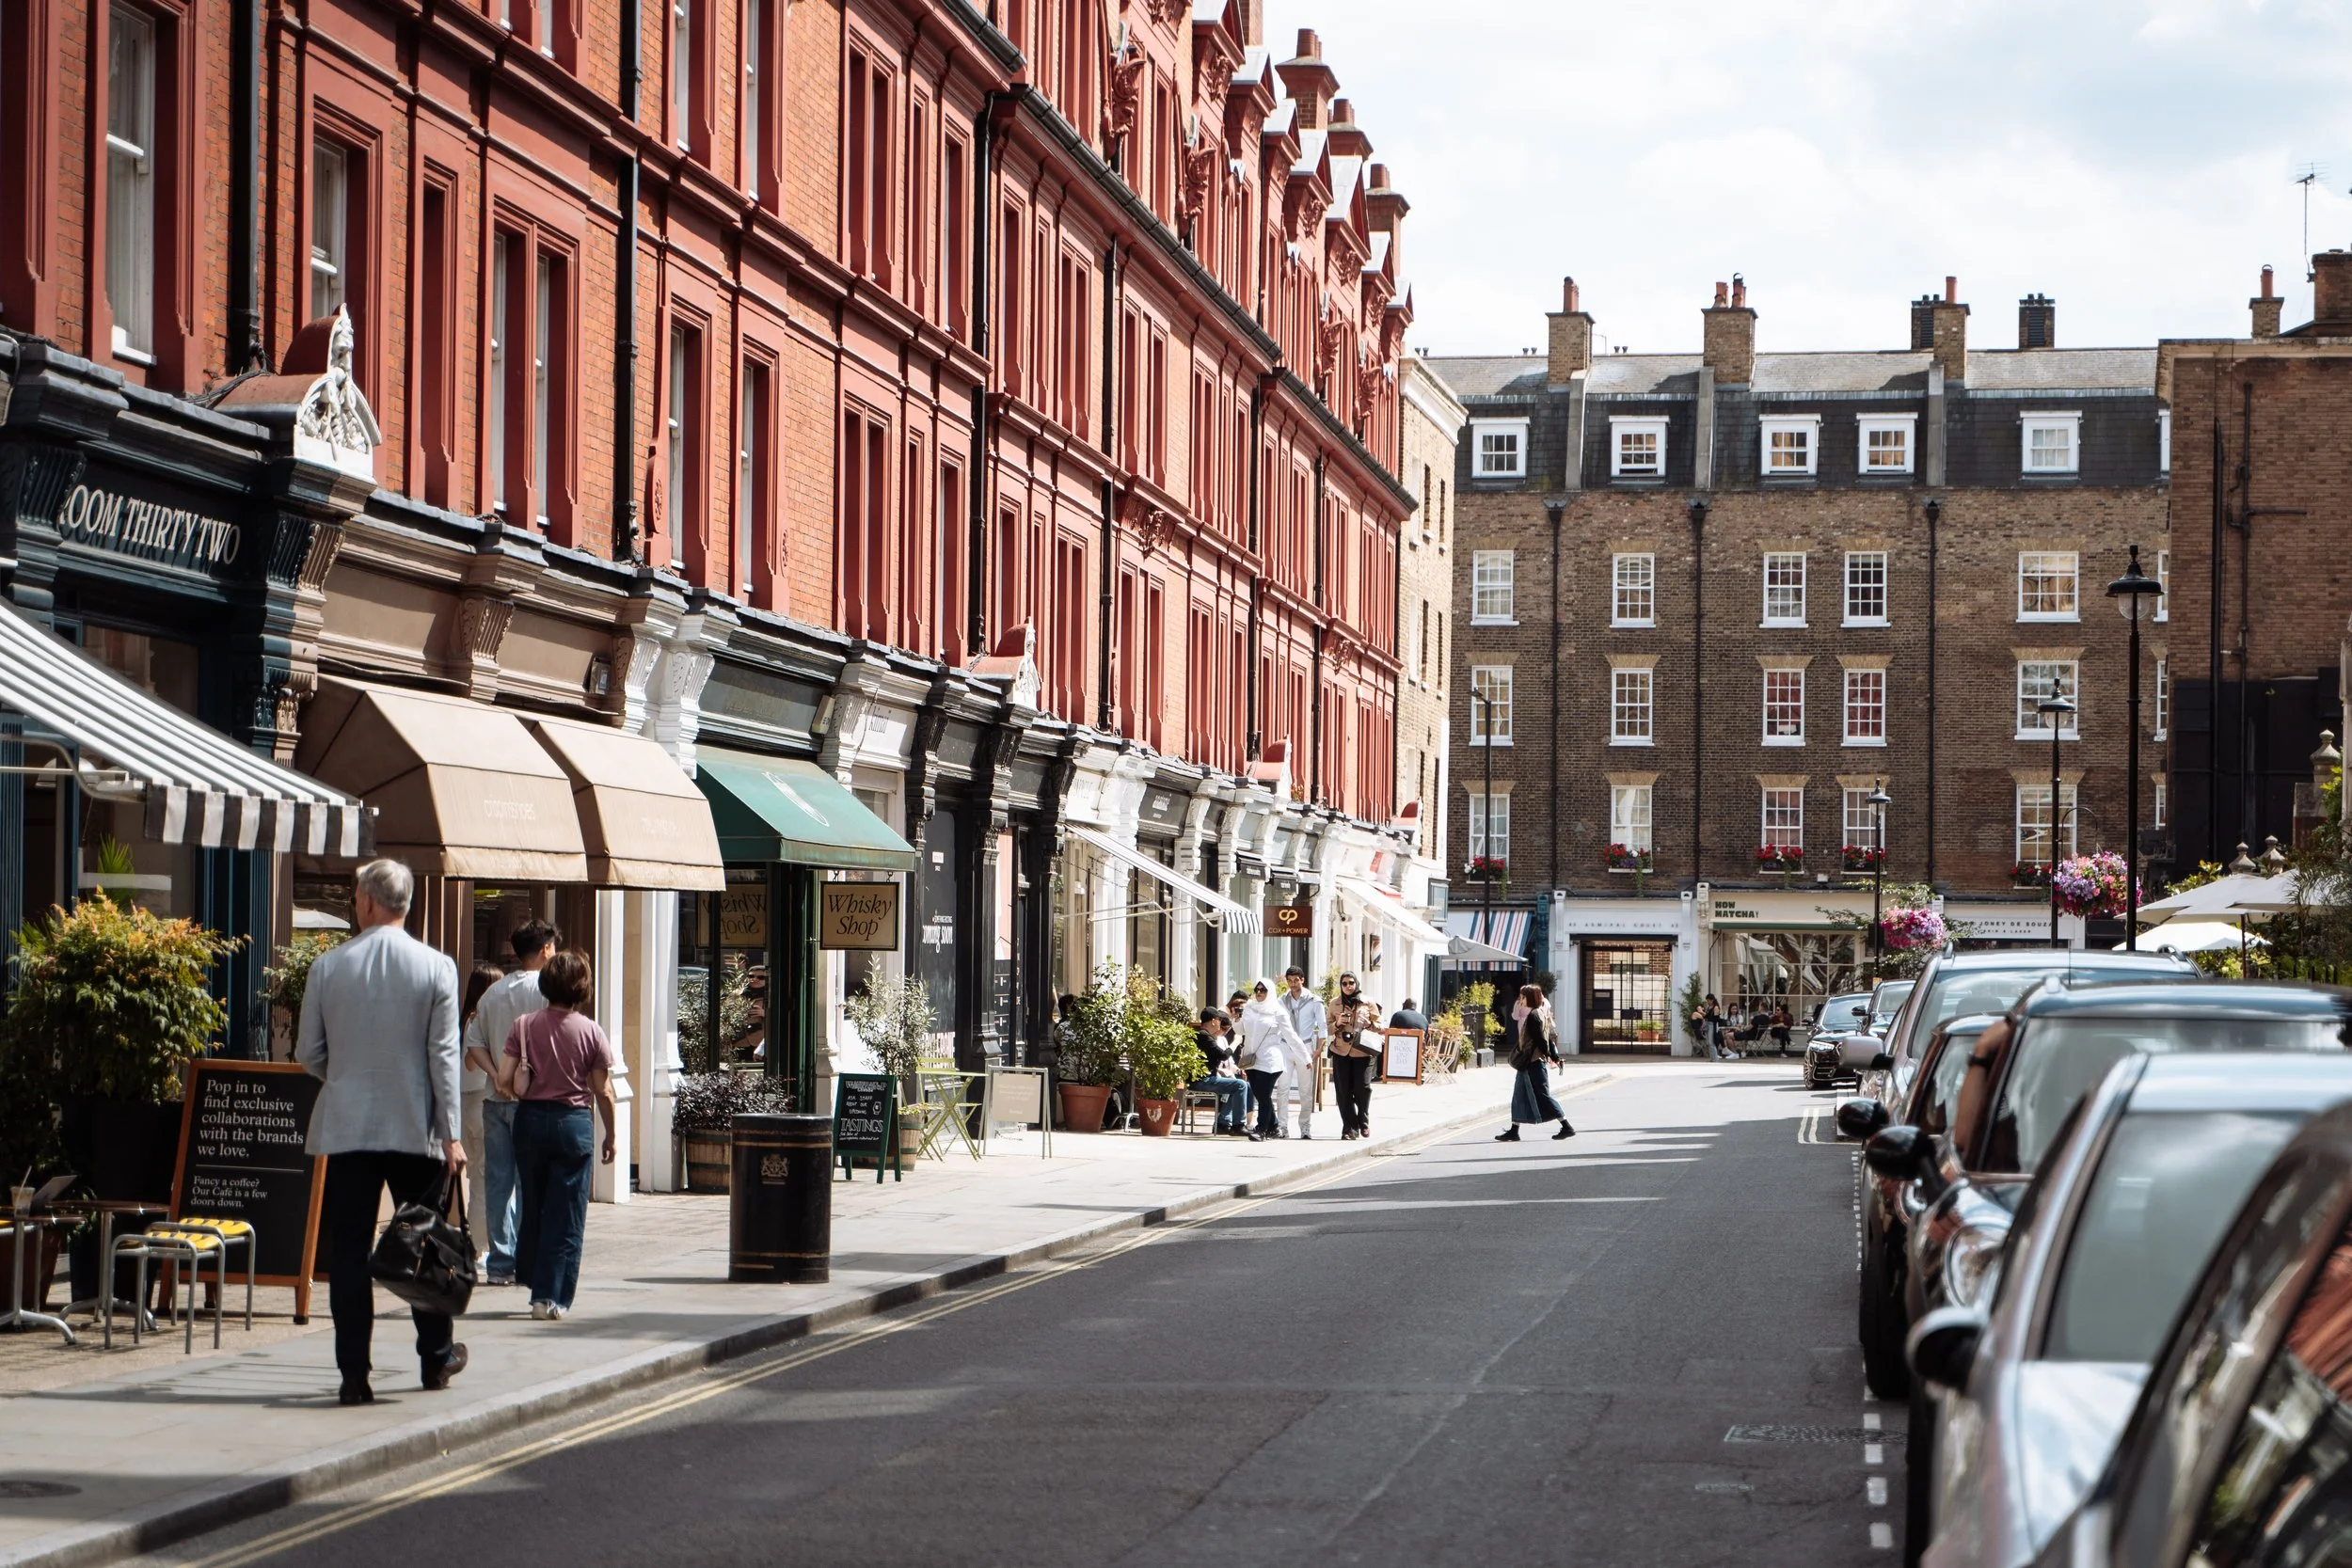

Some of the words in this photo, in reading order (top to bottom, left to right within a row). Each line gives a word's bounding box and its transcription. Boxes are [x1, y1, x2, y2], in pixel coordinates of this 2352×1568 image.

[122, 497, 199, 553] THIRTY
[196, 516, 241, 564] TWO
[828, 894, 892, 920] Whisky
[836, 916, 879, 941] Shop
[207, 1079, 231, 1095] Pop
[235, 1080, 248, 1093] in
[252, 1083, 266, 1094] to
[203, 1095, 230, 1108] find
[233, 1097, 294, 1112] exclusive
[201, 1111, 295, 1128] collaborations
[840, 1117, 883, 1132] TASTINGS
[199, 1127, 228, 1140] with
[232, 1128, 254, 1141] the
[257, 1129, 304, 1145] brands
[197, 1145, 215, 1155] we
[193, 1175, 220, 1186] Fancy
[229, 1178, 260, 1188] coffee?
[192, 1186, 210, 1196] Our
[212, 1186, 232, 1196] Café
[234, 1188, 242, 1197] is
[251, 1189, 268, 1198] few
[190, 1196, 215, 1206] doors
[216, 1197, 245, 1208] down.
